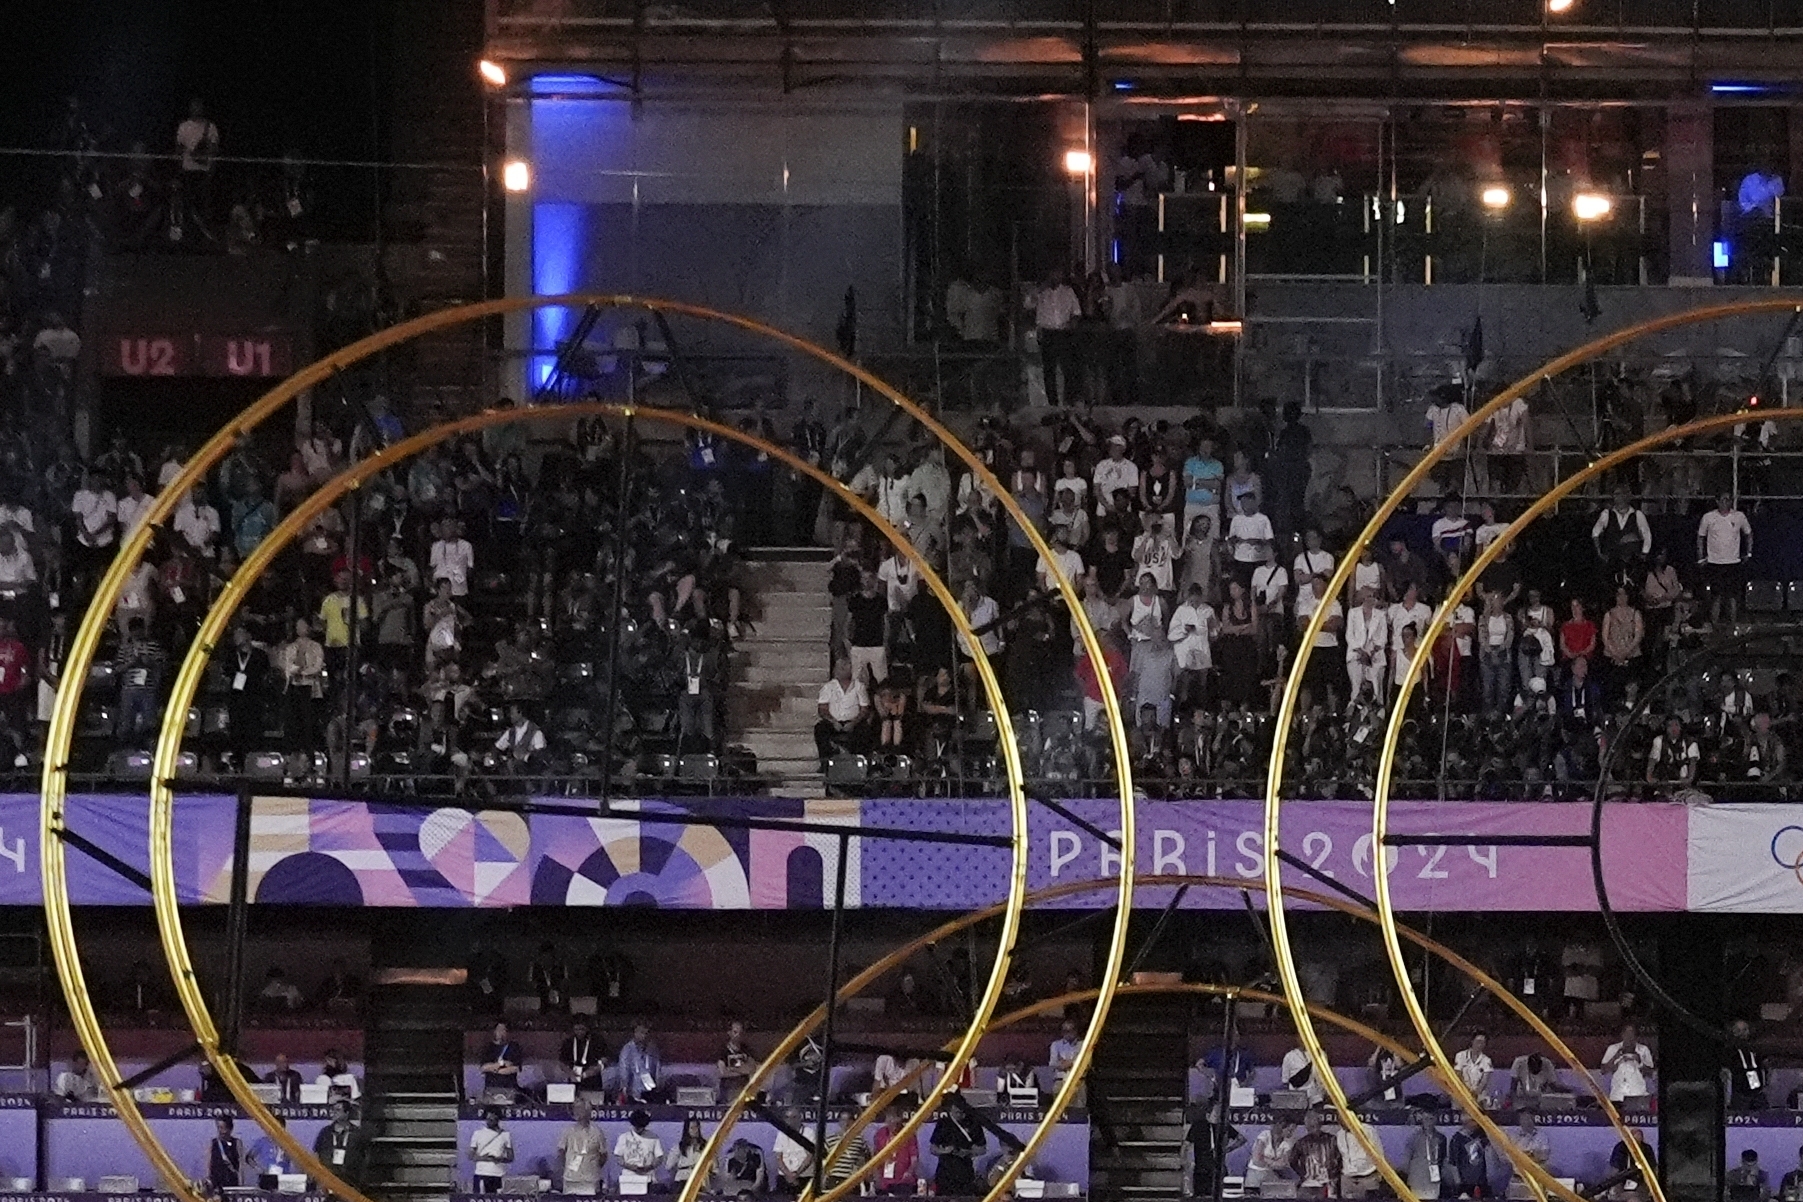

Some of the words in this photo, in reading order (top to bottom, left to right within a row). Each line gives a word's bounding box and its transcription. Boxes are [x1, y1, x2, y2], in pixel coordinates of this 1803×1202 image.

[121, 339, 174, 375] U2
[228, 341, 271, 375] U1
[169, 1106, 202, 1117] PARIS
[207, 1106, 238, 1117] 2024
[516, 1107, 547, 1118] 2024
[1243, 1111, 1274, 1122] 2024
[1557, 1113, 1588, 1124] 2024
[1728, 1113, 1759, 1124] 2024
